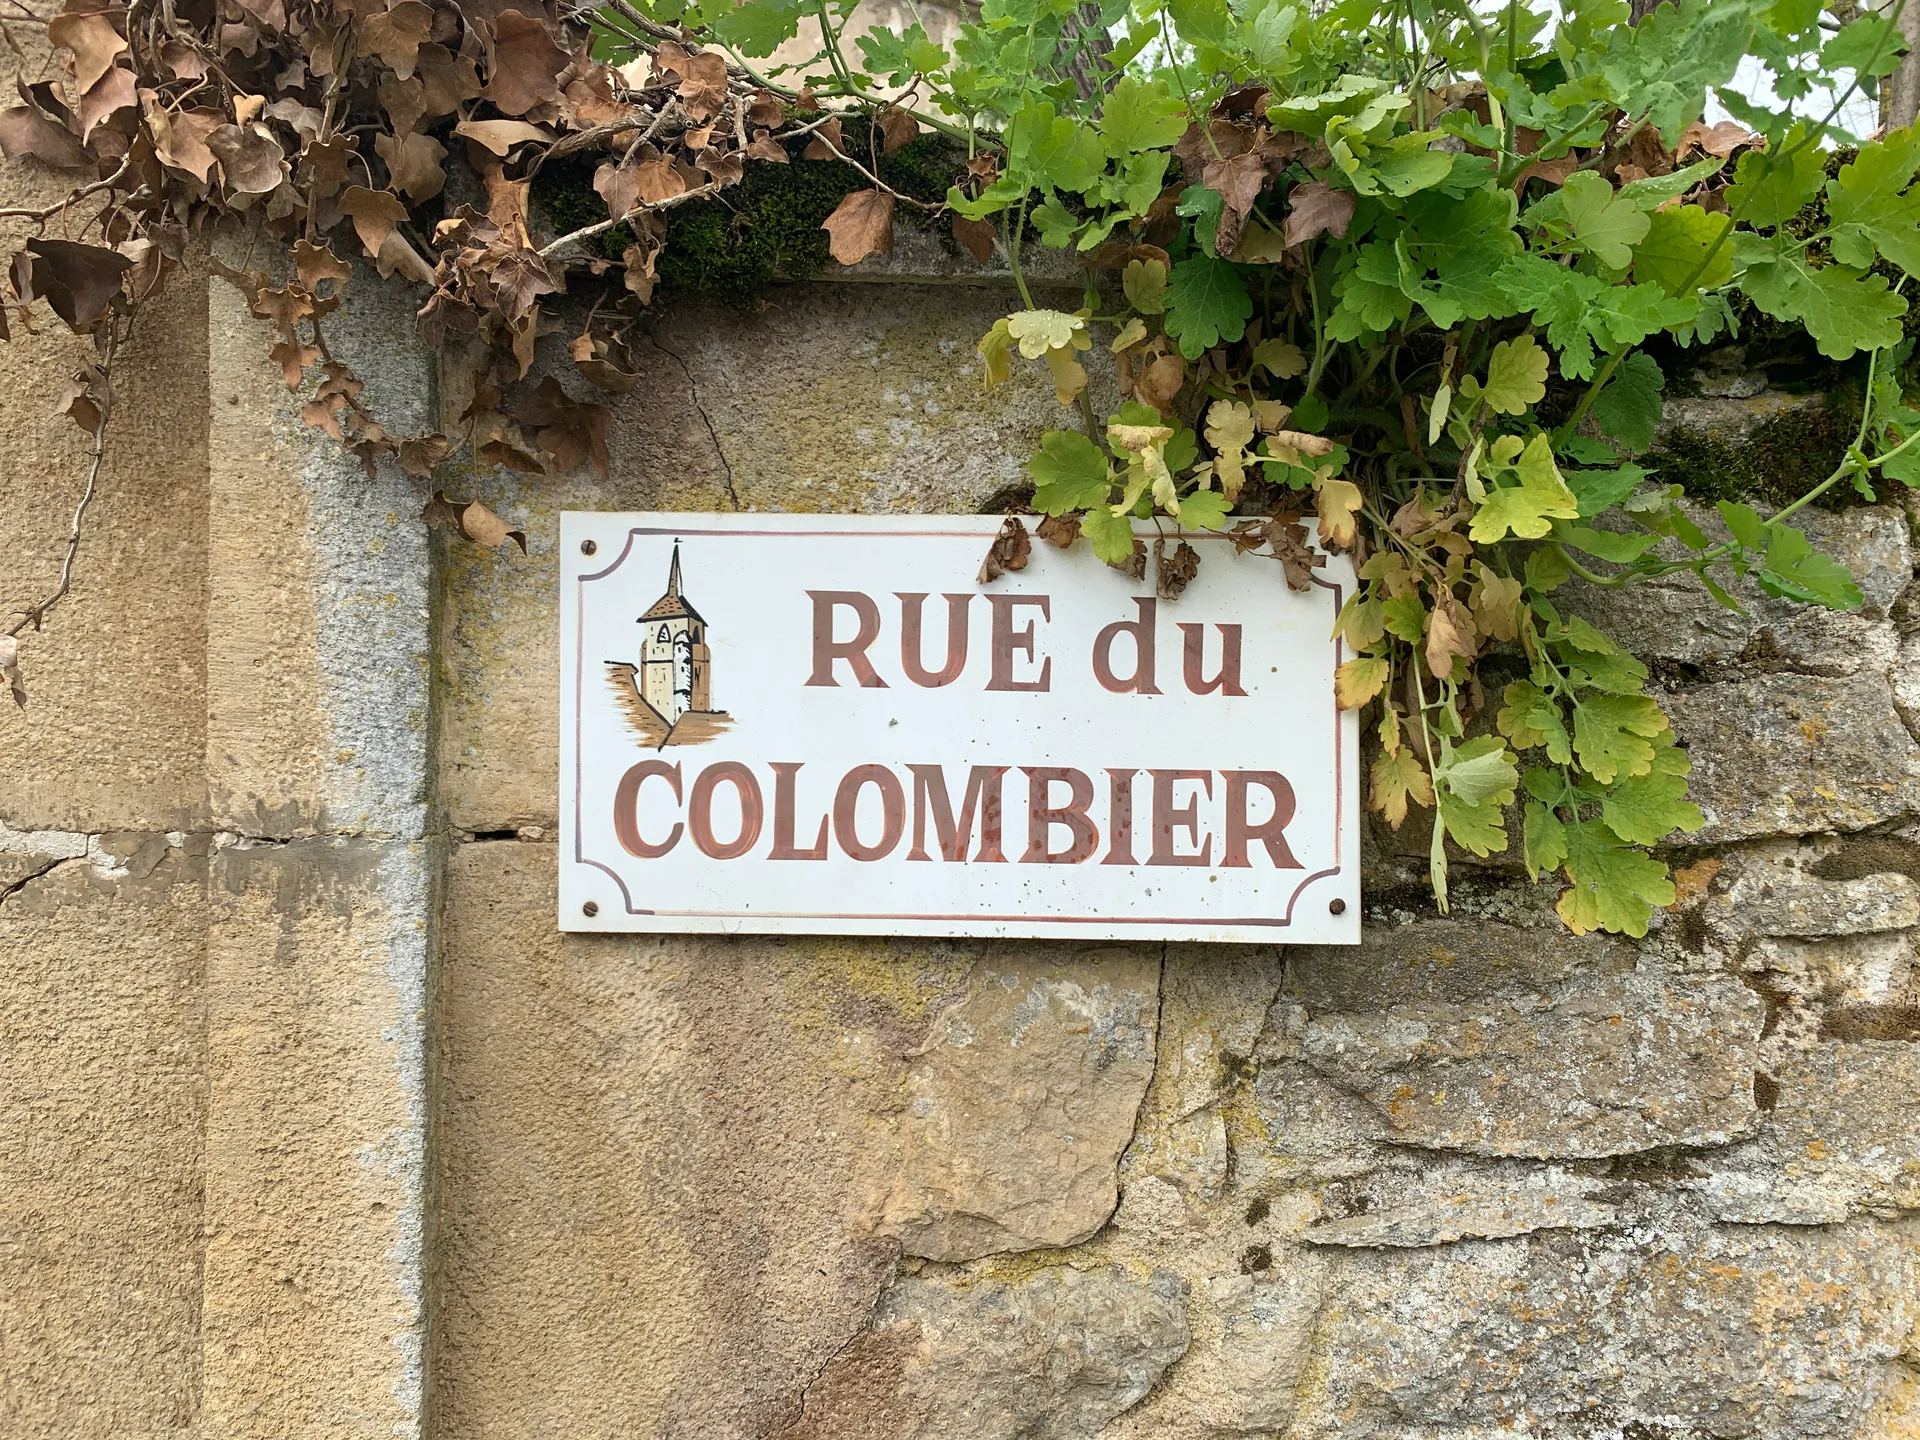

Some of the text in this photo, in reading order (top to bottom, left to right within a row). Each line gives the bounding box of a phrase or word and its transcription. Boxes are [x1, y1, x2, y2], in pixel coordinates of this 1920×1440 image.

[804, 590, 1249, 697] RUE du
[613, 759, 1306, 870] COLOMBIER
